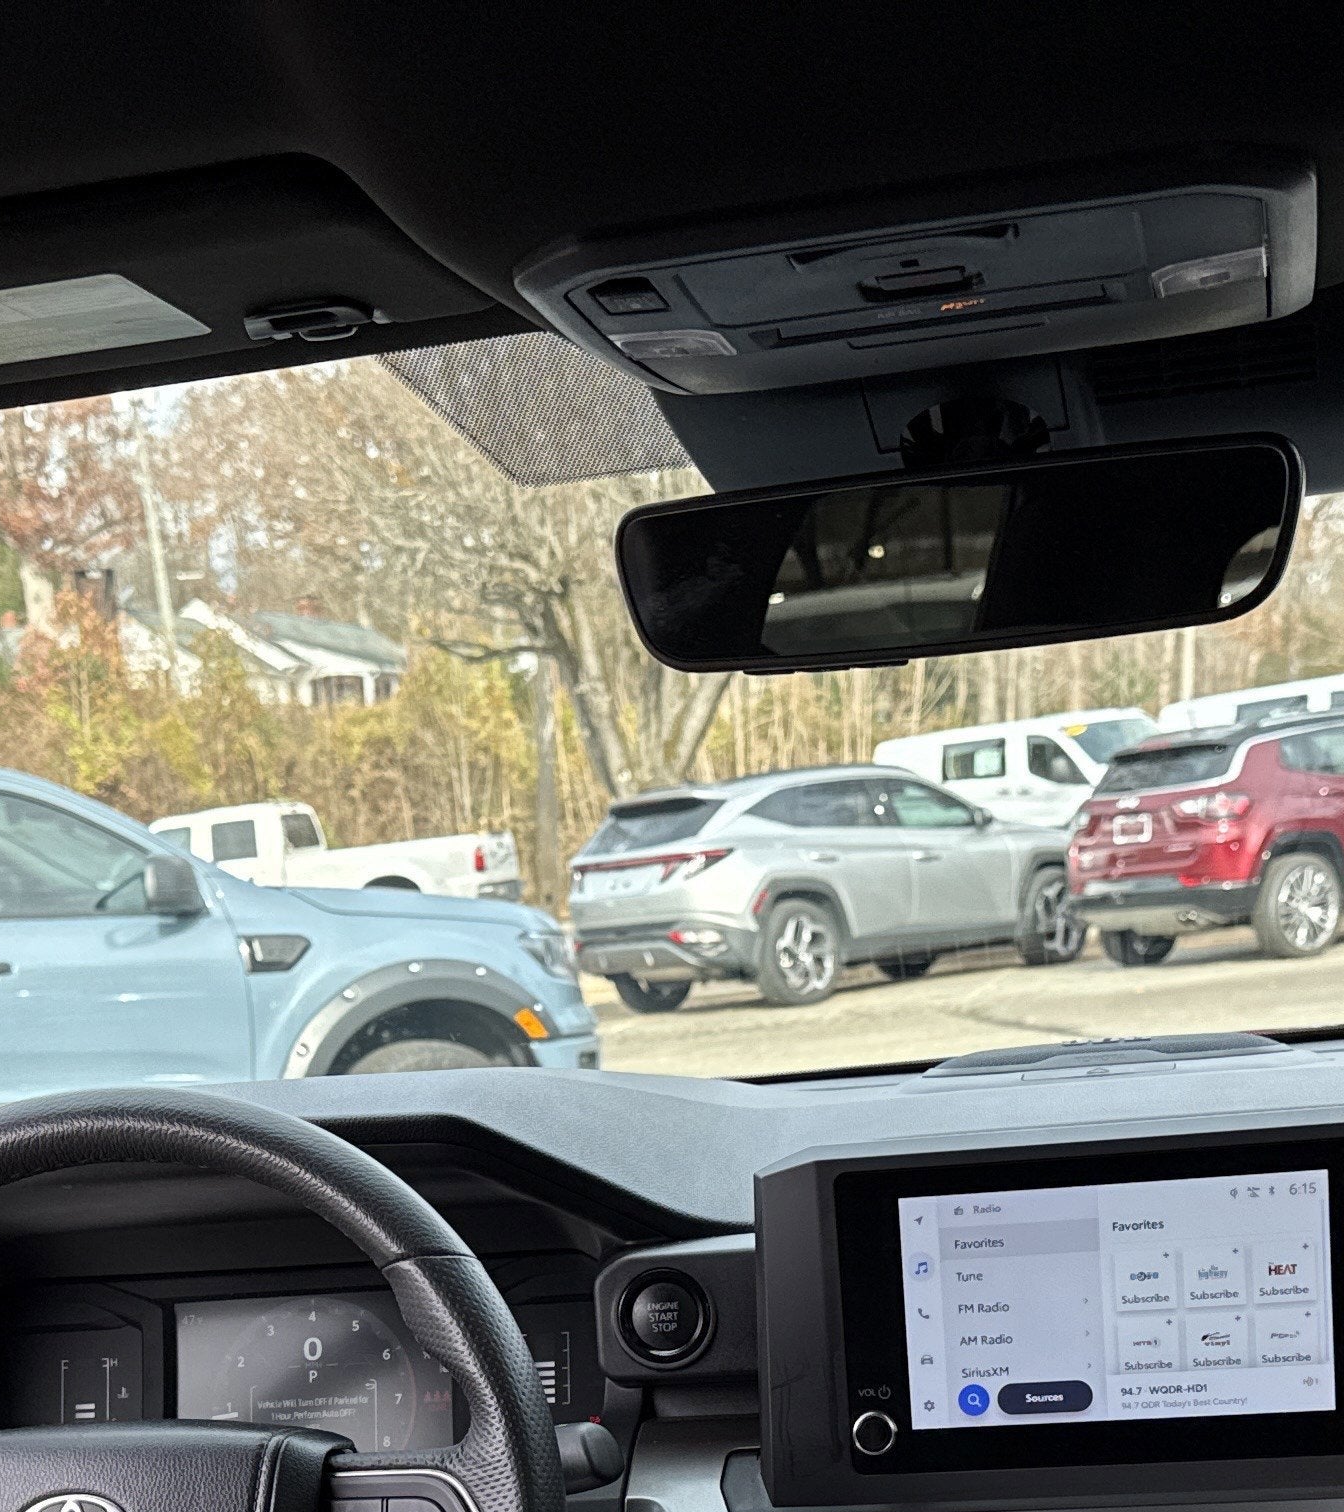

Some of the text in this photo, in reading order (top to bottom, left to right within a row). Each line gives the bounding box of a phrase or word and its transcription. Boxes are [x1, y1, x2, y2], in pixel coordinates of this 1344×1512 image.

[1289, 1182, 1317, 1196] 6:15
[973, 1205, 1001, 1214] Radio
[1113, 1220, 1164, 1232] Favorites
[954, 1238, 1004, 1250] Favorites
[1268, 1264, 1297, 1276] HEAT
[956, 1272, 983, 1283] Tune
[1190, 1290, 1239, 1300] Subscribe
[1259, 1286, 1309, 1296] Subscribe
[1122, 1294, 1170, 1304] Subscribe
[647, 1301, 679, 1311] ENGINE
[958, 1303, 1009, 1314] FM Radio
[308, 1311, 316, 1322] 4
[648, 1312, 679, 1322] START
[267, 1325, 275, 1336] 3
[352, 1320, 360, 1332] 5
[652, 1322, 678, 1332] STOP
[960, 1334, 1013, 1346] AM Radio
[303, 1337, 323, 1361] 0
[382, 1349, 391, 1360] 6
[237, 1356, 245, 1368] 2
[1193, 1357, 1241, 1368] Subscribe
[1262, 1354, 1311, 1364] Subscribe
[1125, 1361, 1173, 1371] Subscribe
[309, 1370, 318, 1383] P
[961, 1367, 1009, 1378] SiriusXM
[858, 1388, 875, 1397] VOL
[1121, 1384, 1208, 1396] 94.7 WQDR-HD1
[315, 1398, 327, 1406] OFF
[394, 1394, 402, 1405] 7
[1025, 1393, 1064, 1403] Sources
[1122, 1397, 1247, 1410] 94.7 QDR Today's Best Country!
[226, 1402, 232, 1412] 1
[383, 1436, 391, 1447] 8
